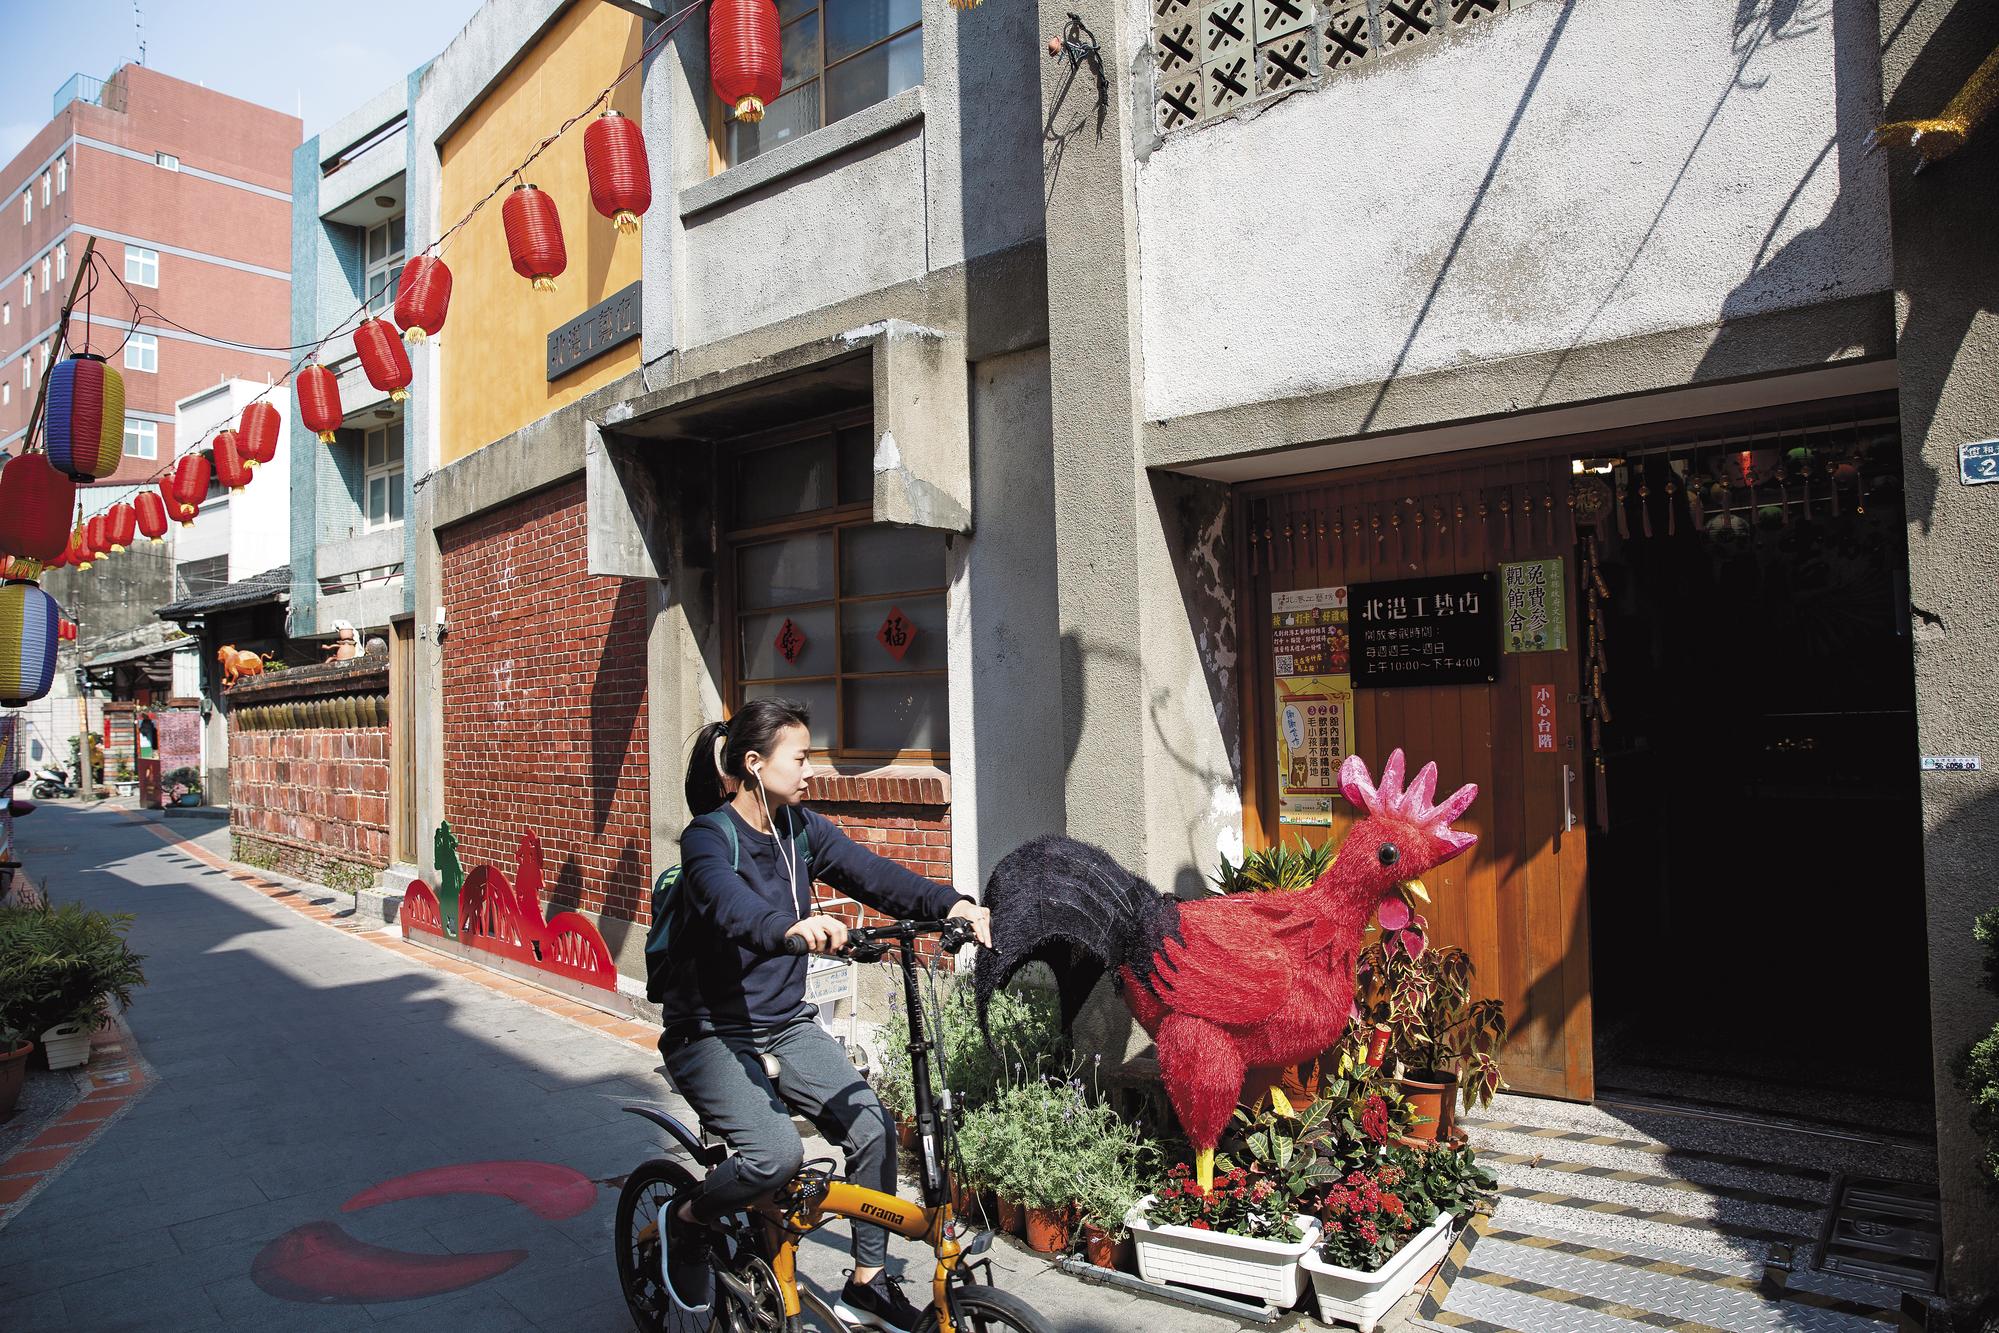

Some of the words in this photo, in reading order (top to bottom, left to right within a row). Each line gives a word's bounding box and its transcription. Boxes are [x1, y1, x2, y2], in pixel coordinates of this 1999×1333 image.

[1981, 459, 1996, 476] 2
[1362, 591, 1479, 621] 北港工藝坊
[1505, 566, 1527, 632] 觀館舍
[1527, 564, 1549, 632] 免費參
[884, 617, 907, 647] 福
[1536, 688, 1552, 748] 小心台階
